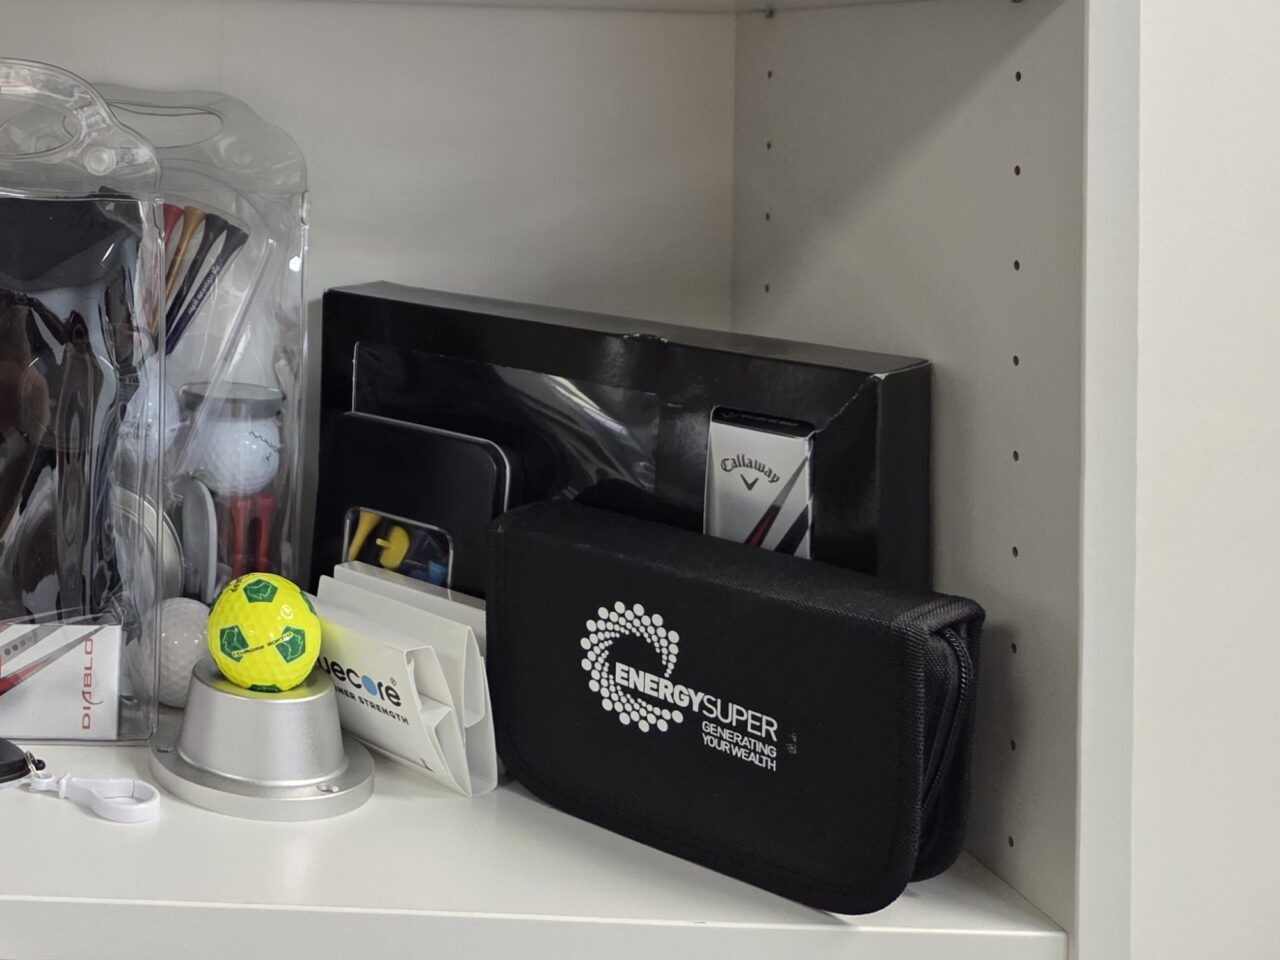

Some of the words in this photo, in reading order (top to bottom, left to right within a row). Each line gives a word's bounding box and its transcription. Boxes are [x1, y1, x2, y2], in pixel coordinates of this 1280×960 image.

[720, 453, 780, 483] Callaway
[82, 636, 104, 730] DIABLO
[615, 661, 778, 742] ENERGYSUPER
[358, 696, 409, 725] STRENGTH
[701, 720, 777, 758] GENERATING
[701, 733, 730, 754] YOUR
[730, 744, 777, 772] WEALTH
